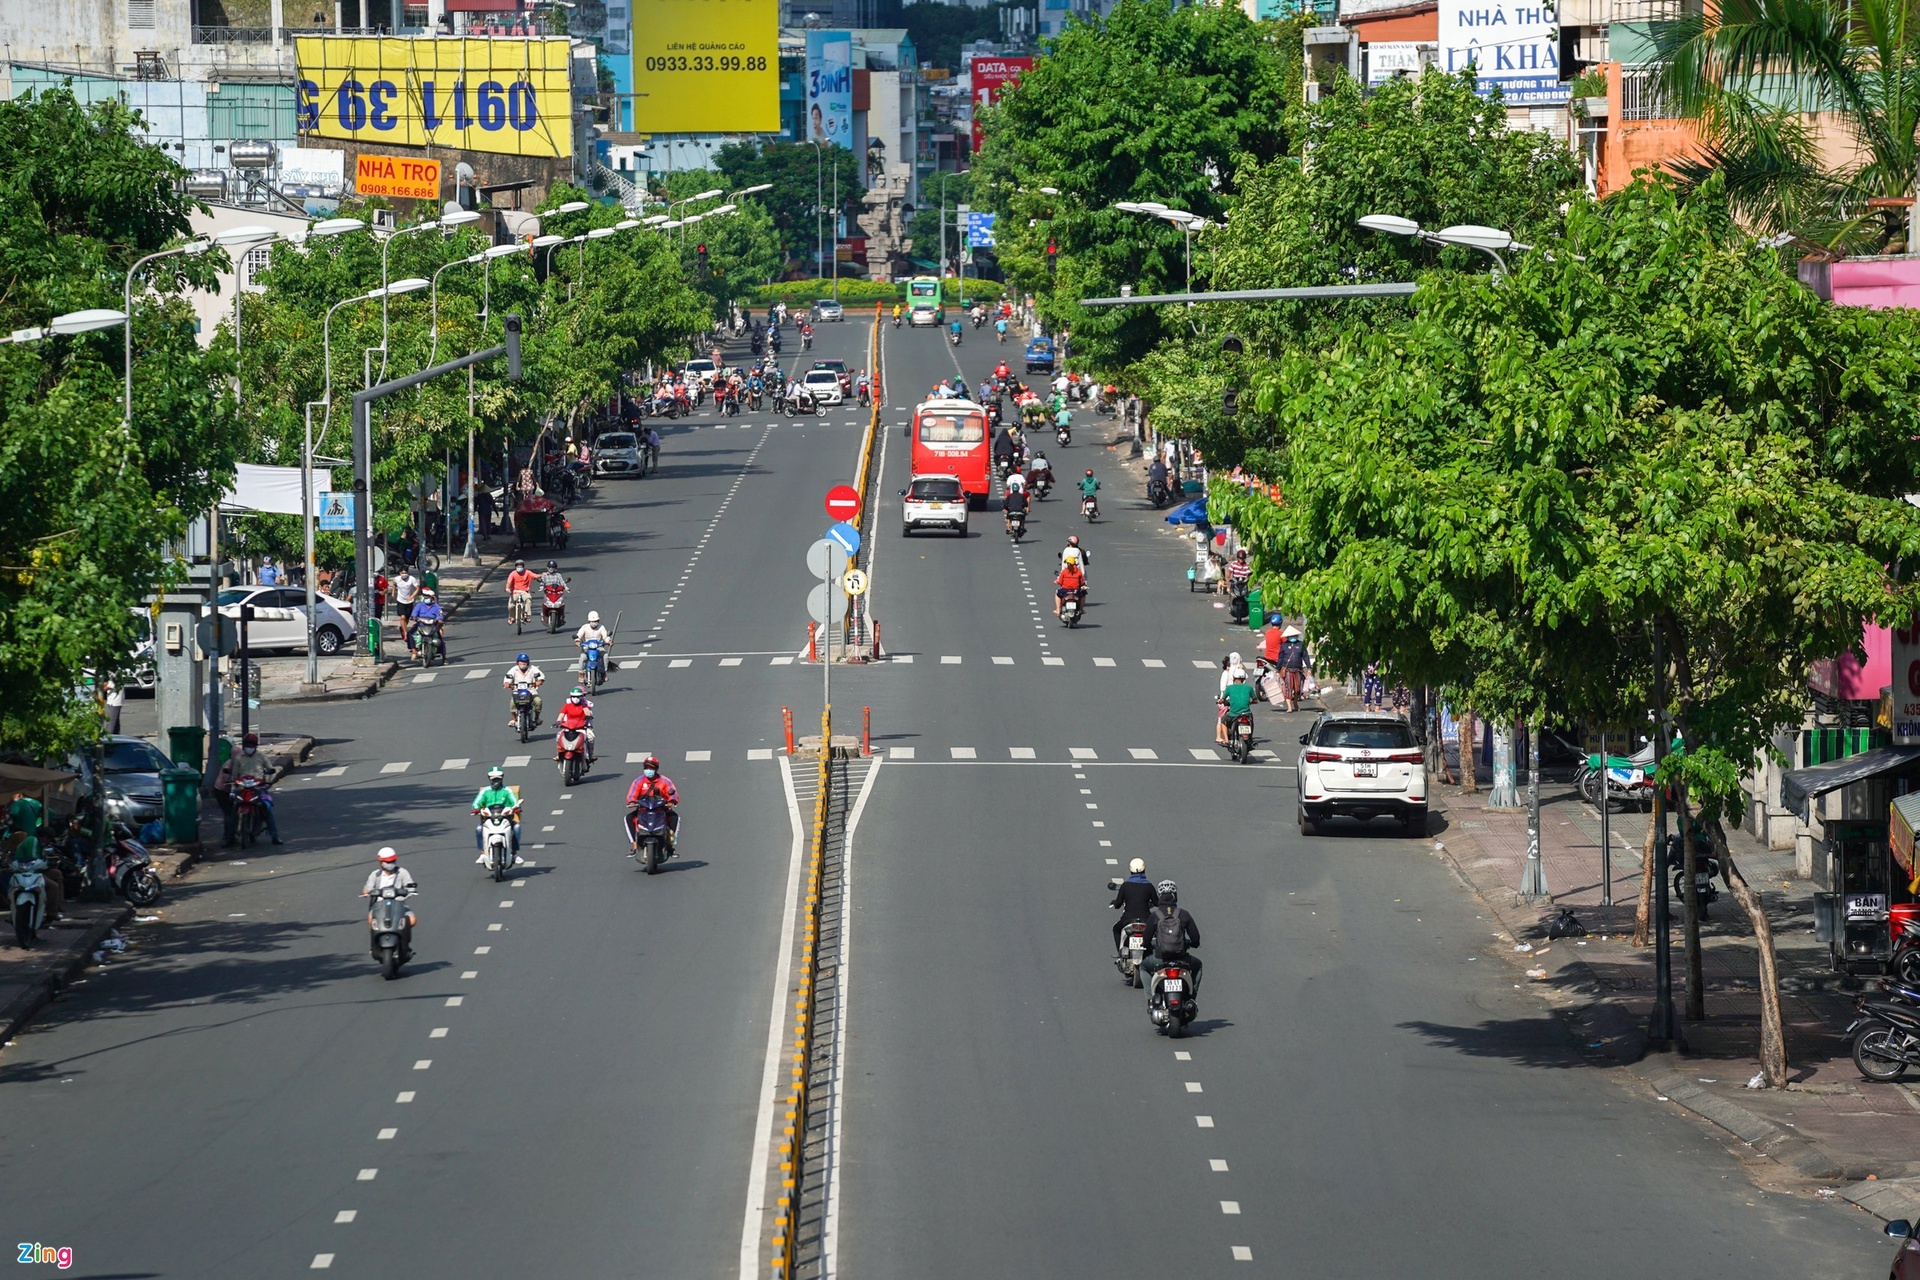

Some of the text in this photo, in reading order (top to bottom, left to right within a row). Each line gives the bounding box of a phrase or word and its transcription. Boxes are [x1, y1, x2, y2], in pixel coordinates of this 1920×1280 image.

[1458, 4, 1507, 27] NHÀ
[645, 56, 767, 72] 0933.33.99.88
[977, 62, 1007, 73] DATA
[809, 68, 821, 99] 3
[358, 157, 438, 186] NHÀ TRỌ
[360, 184, 434, 198] 0908.166.686
